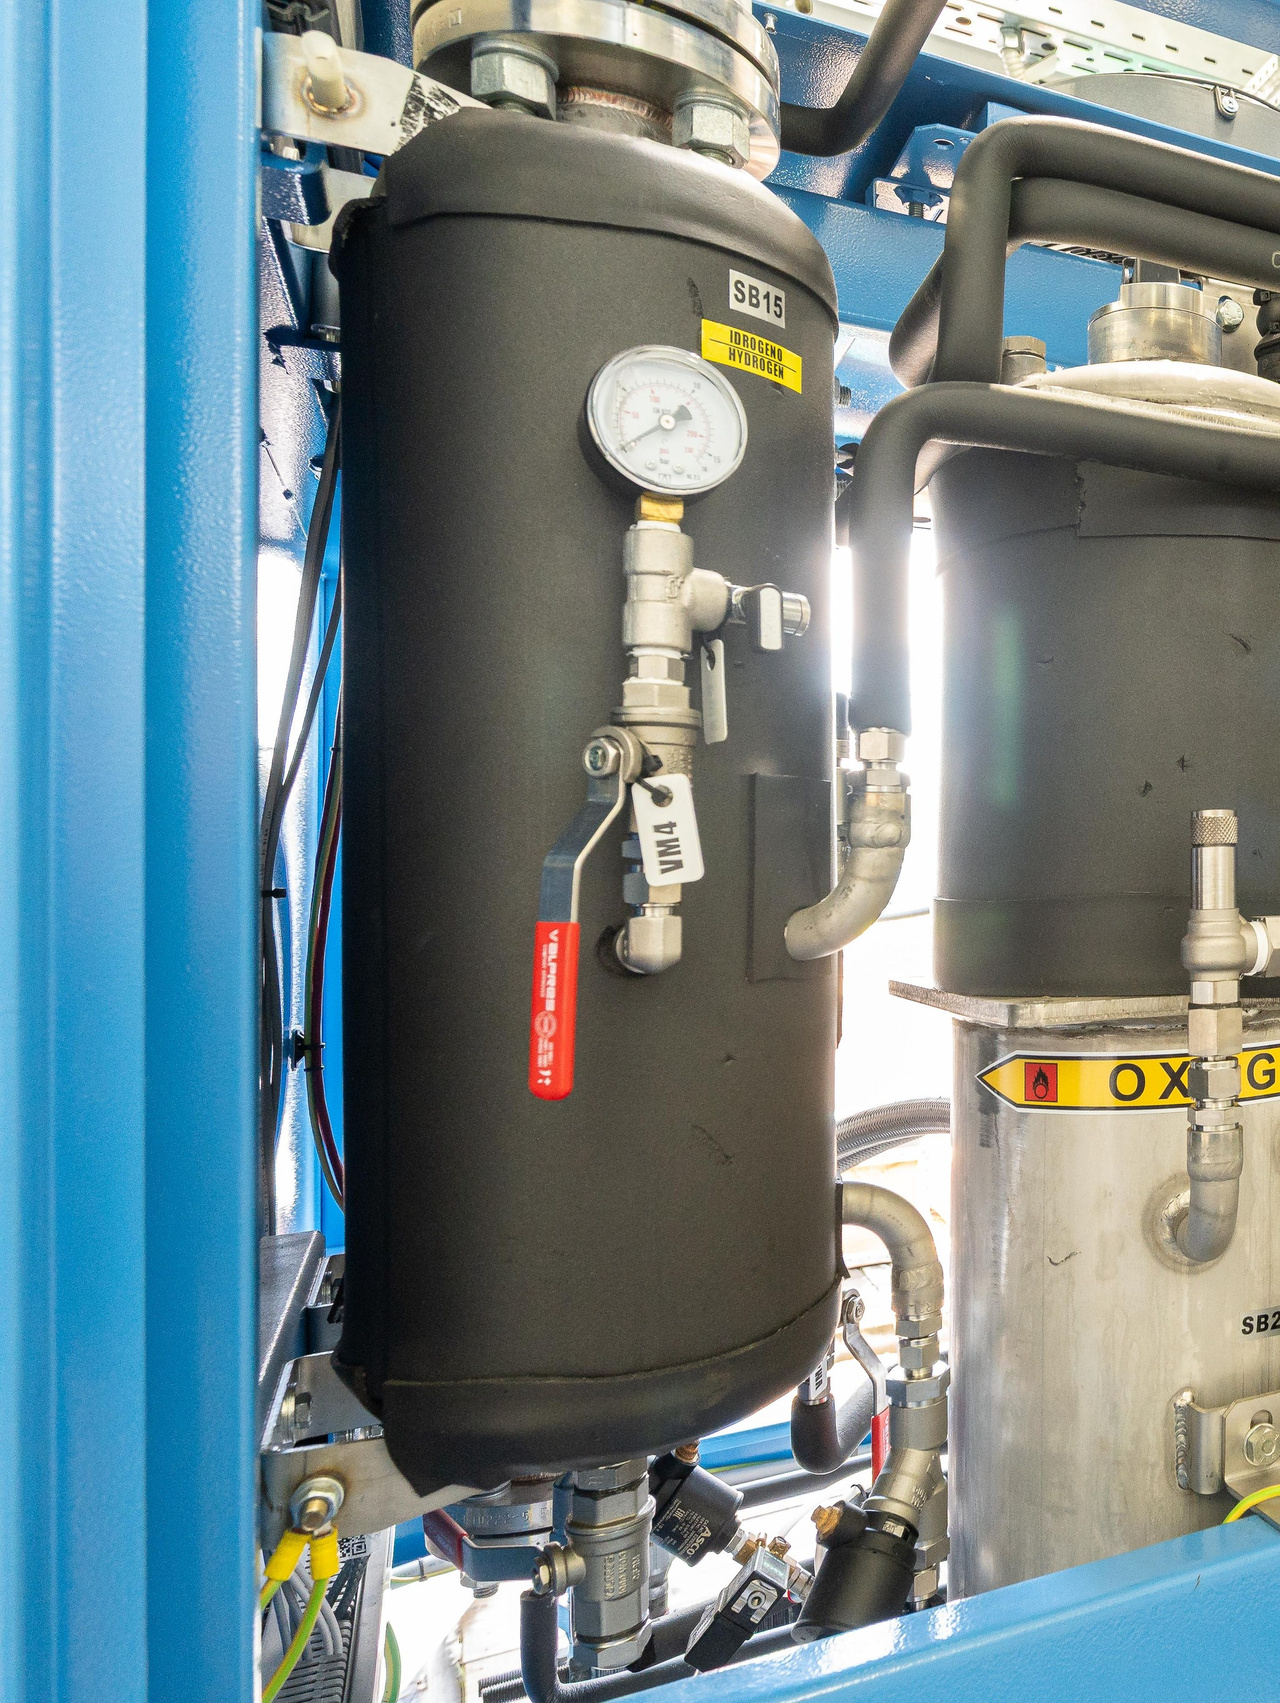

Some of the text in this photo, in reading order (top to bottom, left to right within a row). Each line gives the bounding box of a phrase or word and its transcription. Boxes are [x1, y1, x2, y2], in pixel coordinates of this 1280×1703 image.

[733, 280, 783, 319] SB15
[730, 330, 783, 362] IDROGENO
[729, 347, 784, 380] HYDROGEN
[652, 821, 684, 875] VM4
[686, 1525, 712, 1556] ASCO
